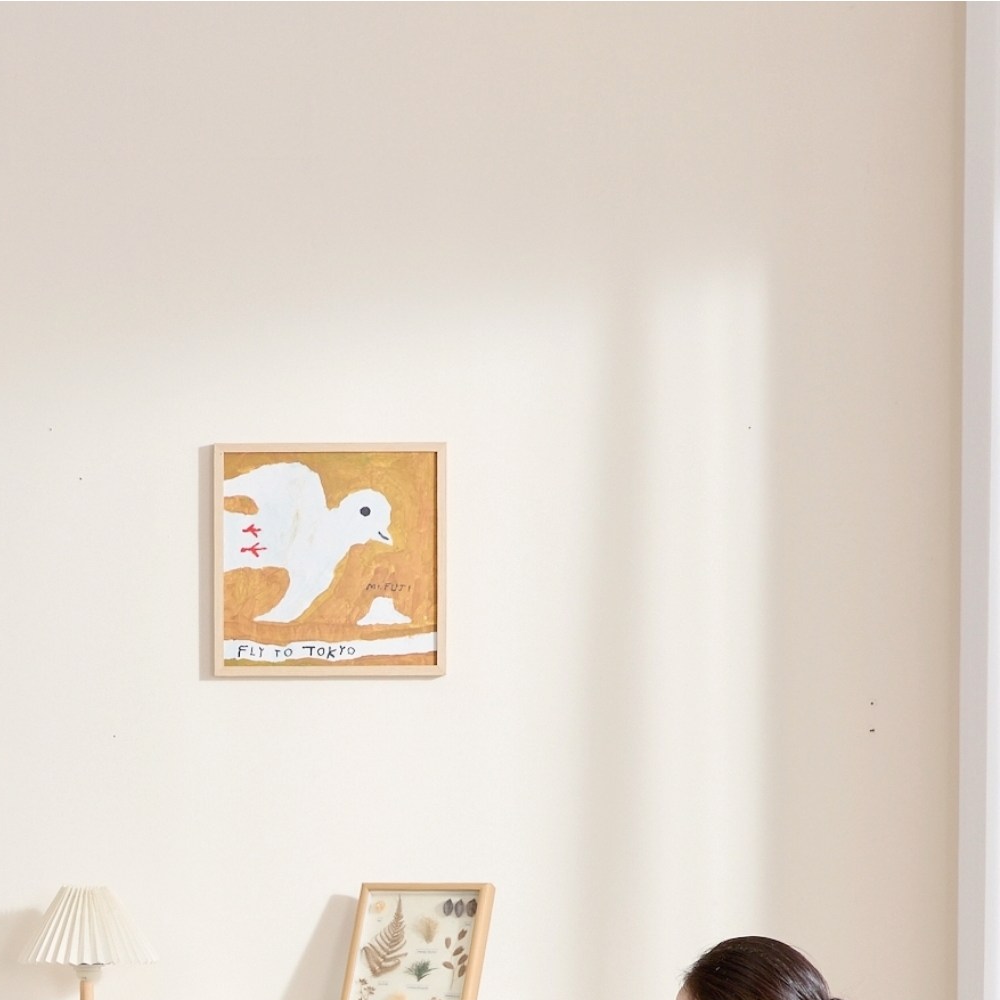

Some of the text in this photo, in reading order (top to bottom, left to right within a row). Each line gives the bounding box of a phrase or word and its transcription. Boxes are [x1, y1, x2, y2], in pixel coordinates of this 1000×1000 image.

[237, 645, 356, 659] FLY TO TOKYO
